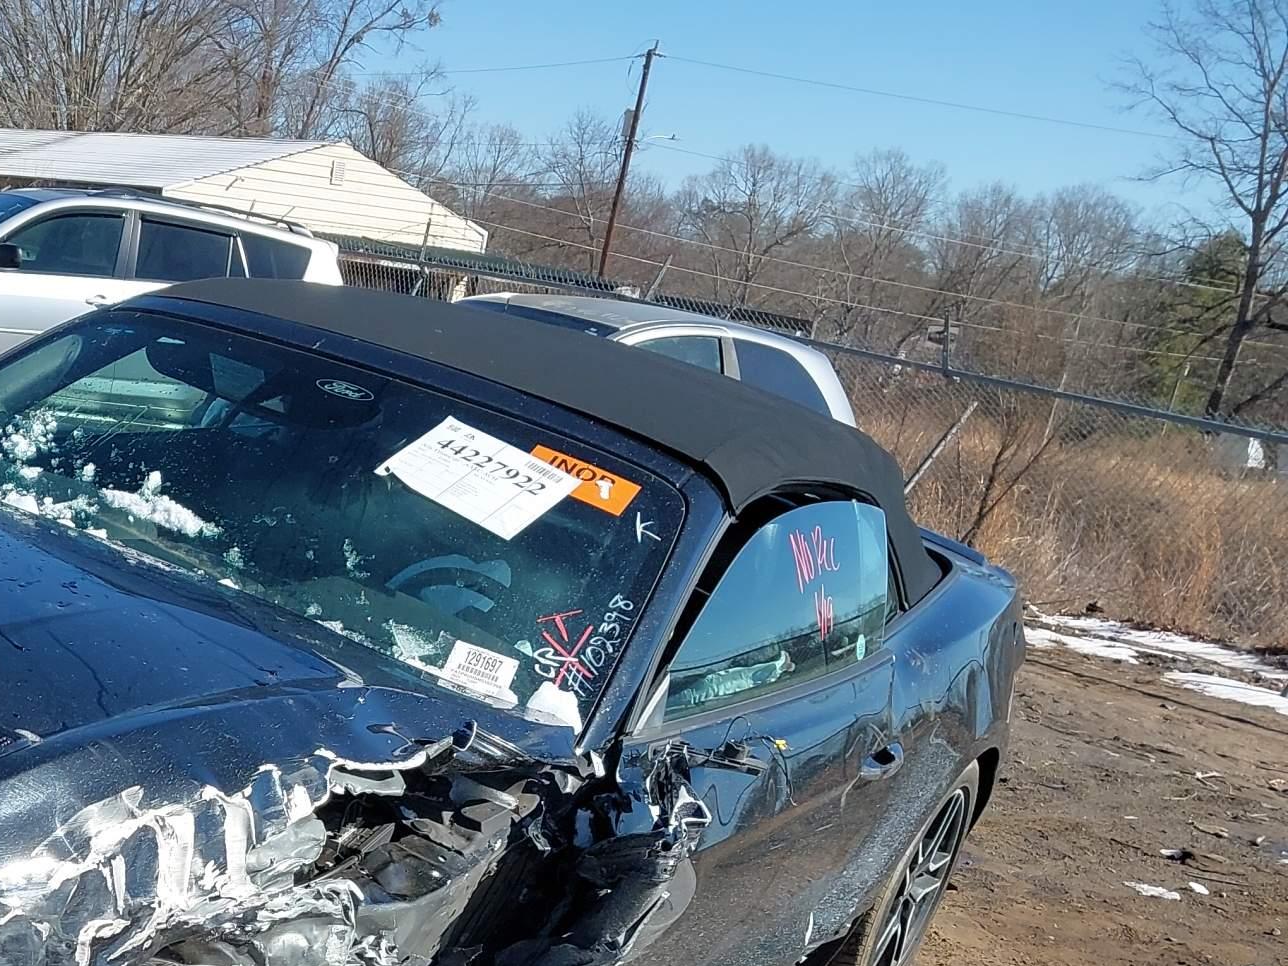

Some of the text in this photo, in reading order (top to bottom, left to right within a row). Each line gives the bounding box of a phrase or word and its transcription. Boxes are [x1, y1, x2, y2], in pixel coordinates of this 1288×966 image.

[321, 381, 368, 399] Ford
[437, 439, 547, 496] 44227922
[464, 650, 504, 674] 1291697
